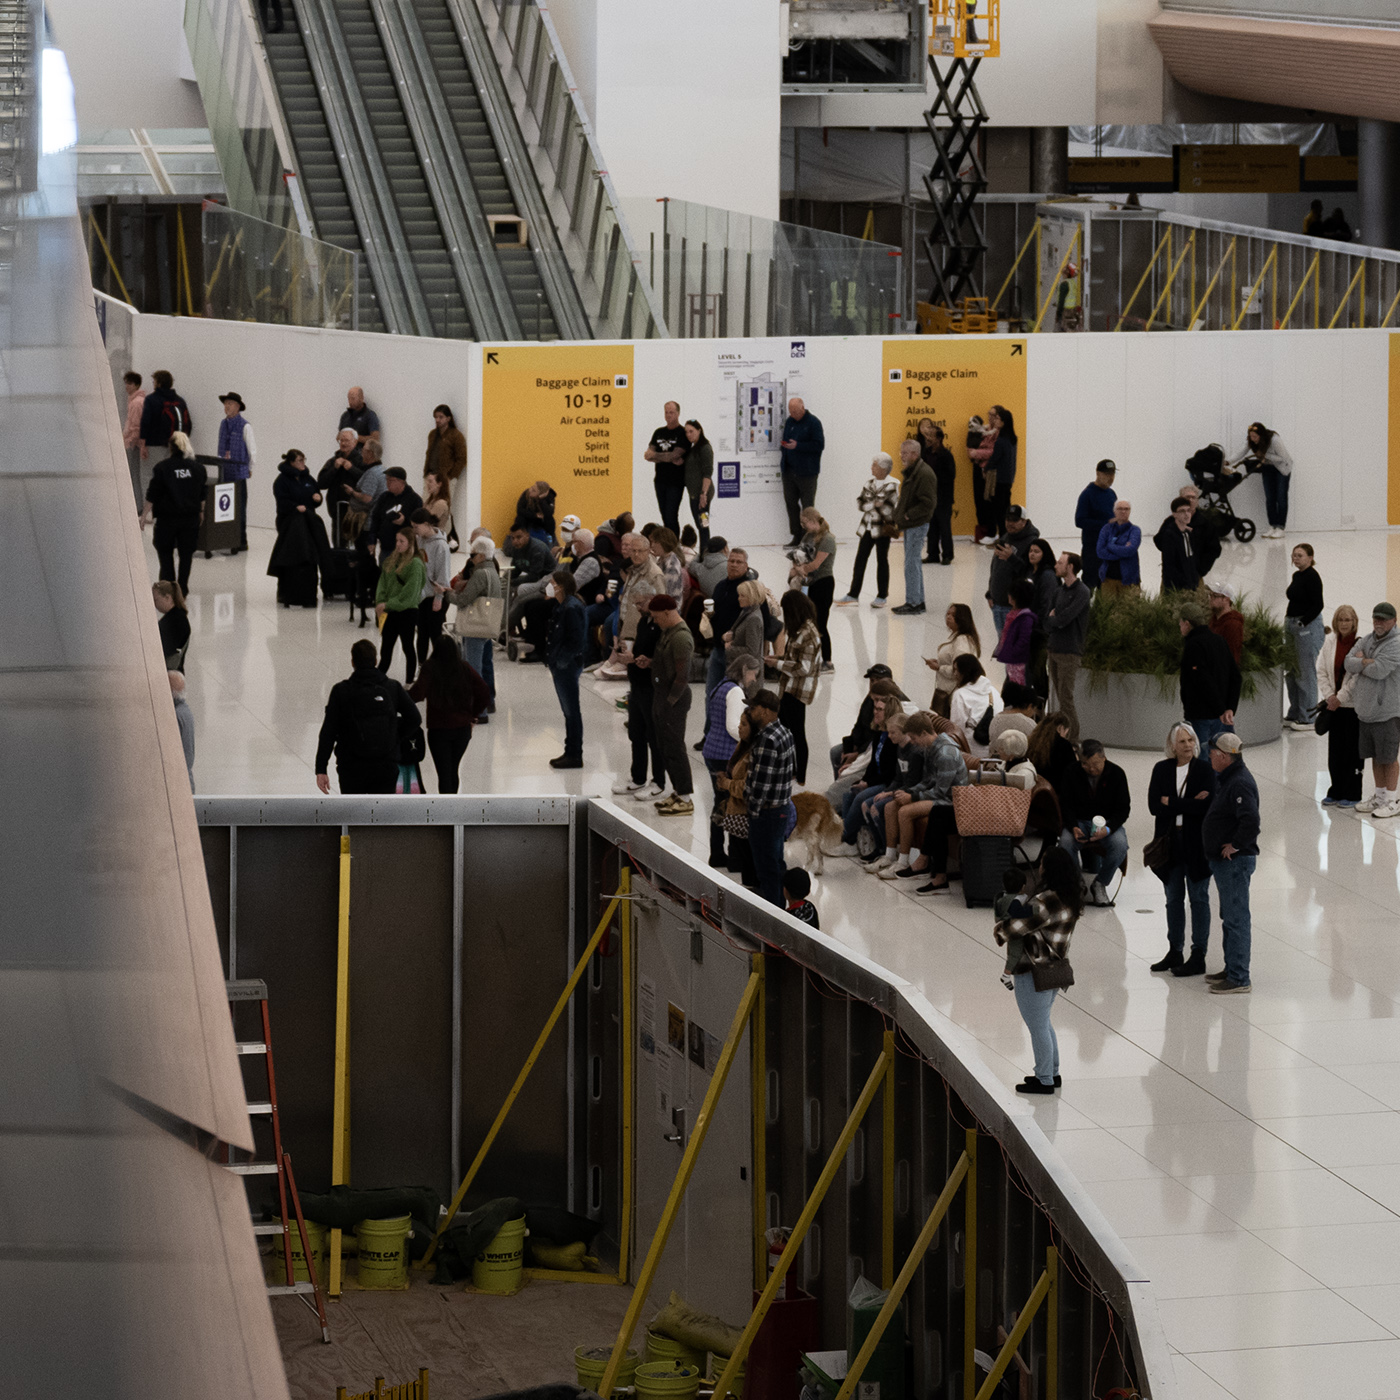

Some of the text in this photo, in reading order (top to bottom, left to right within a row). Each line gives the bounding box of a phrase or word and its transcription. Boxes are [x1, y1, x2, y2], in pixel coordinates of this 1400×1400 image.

[906, 369, 978, 381] Baggage Claim
[536, 377, 611, 389] Baggage Claim
[906, 386, 932, 399] 1-9
[564, 394, 612, 408] 10-19
[906, 406, 936, 415] Alaska
[560, 416, 610, 425] Air Canada
[585, 429, 610, 438] Delta
[585, 442, 610, 452] Spirit
[578, 455, 610, 464] United
[174, 468, 192, 479] TSA
[573, 468, 610, 477] WestJet
